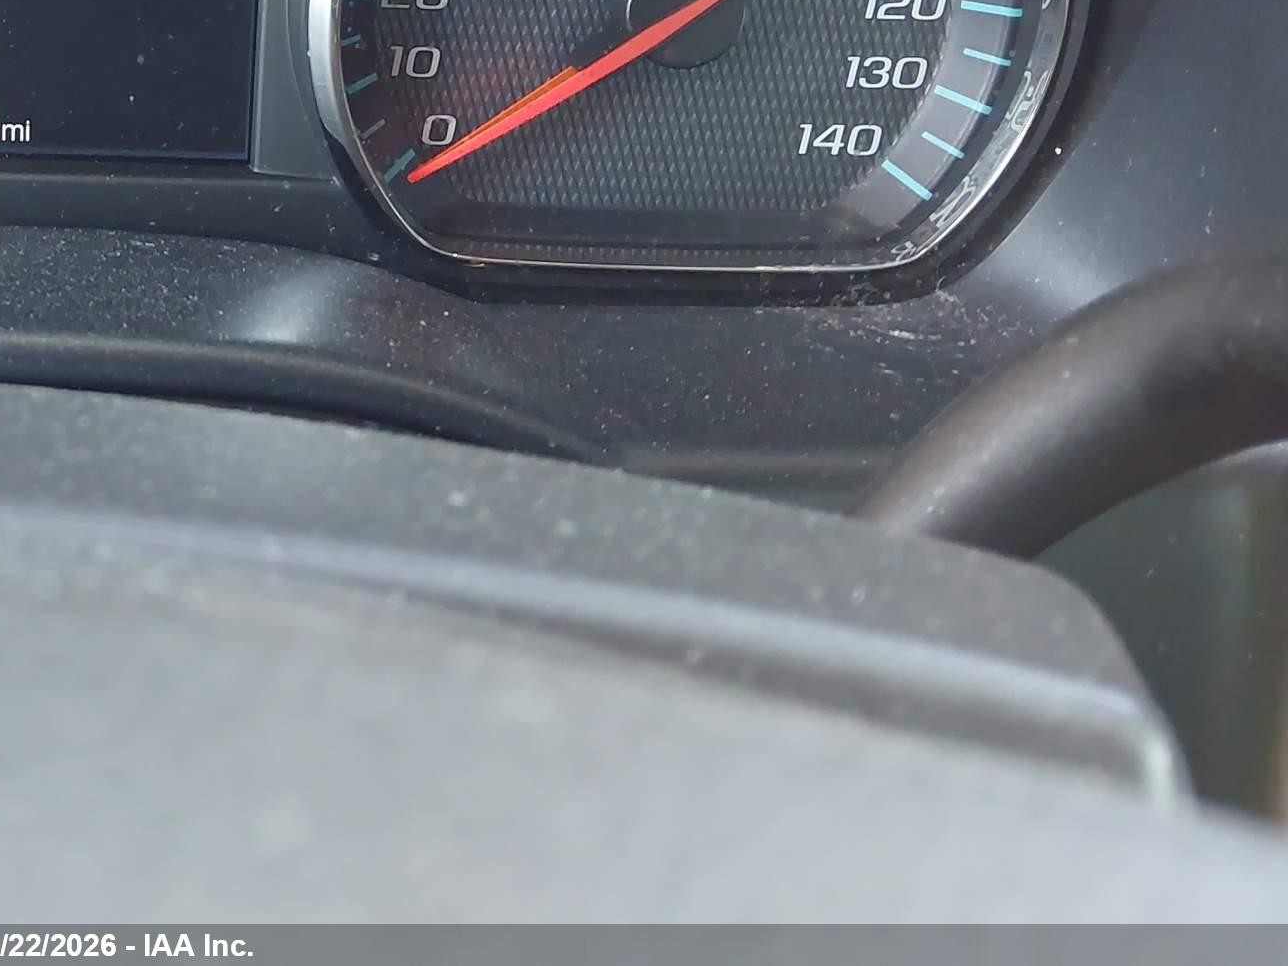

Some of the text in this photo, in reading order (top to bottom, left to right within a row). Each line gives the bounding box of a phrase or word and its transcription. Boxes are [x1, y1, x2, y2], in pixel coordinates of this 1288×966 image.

[391, 46, 441, 79] 10
[845, 57, 927, 89] 130
[422, 114, 457, 146] 0
[797, 124, 883, 157] 140
